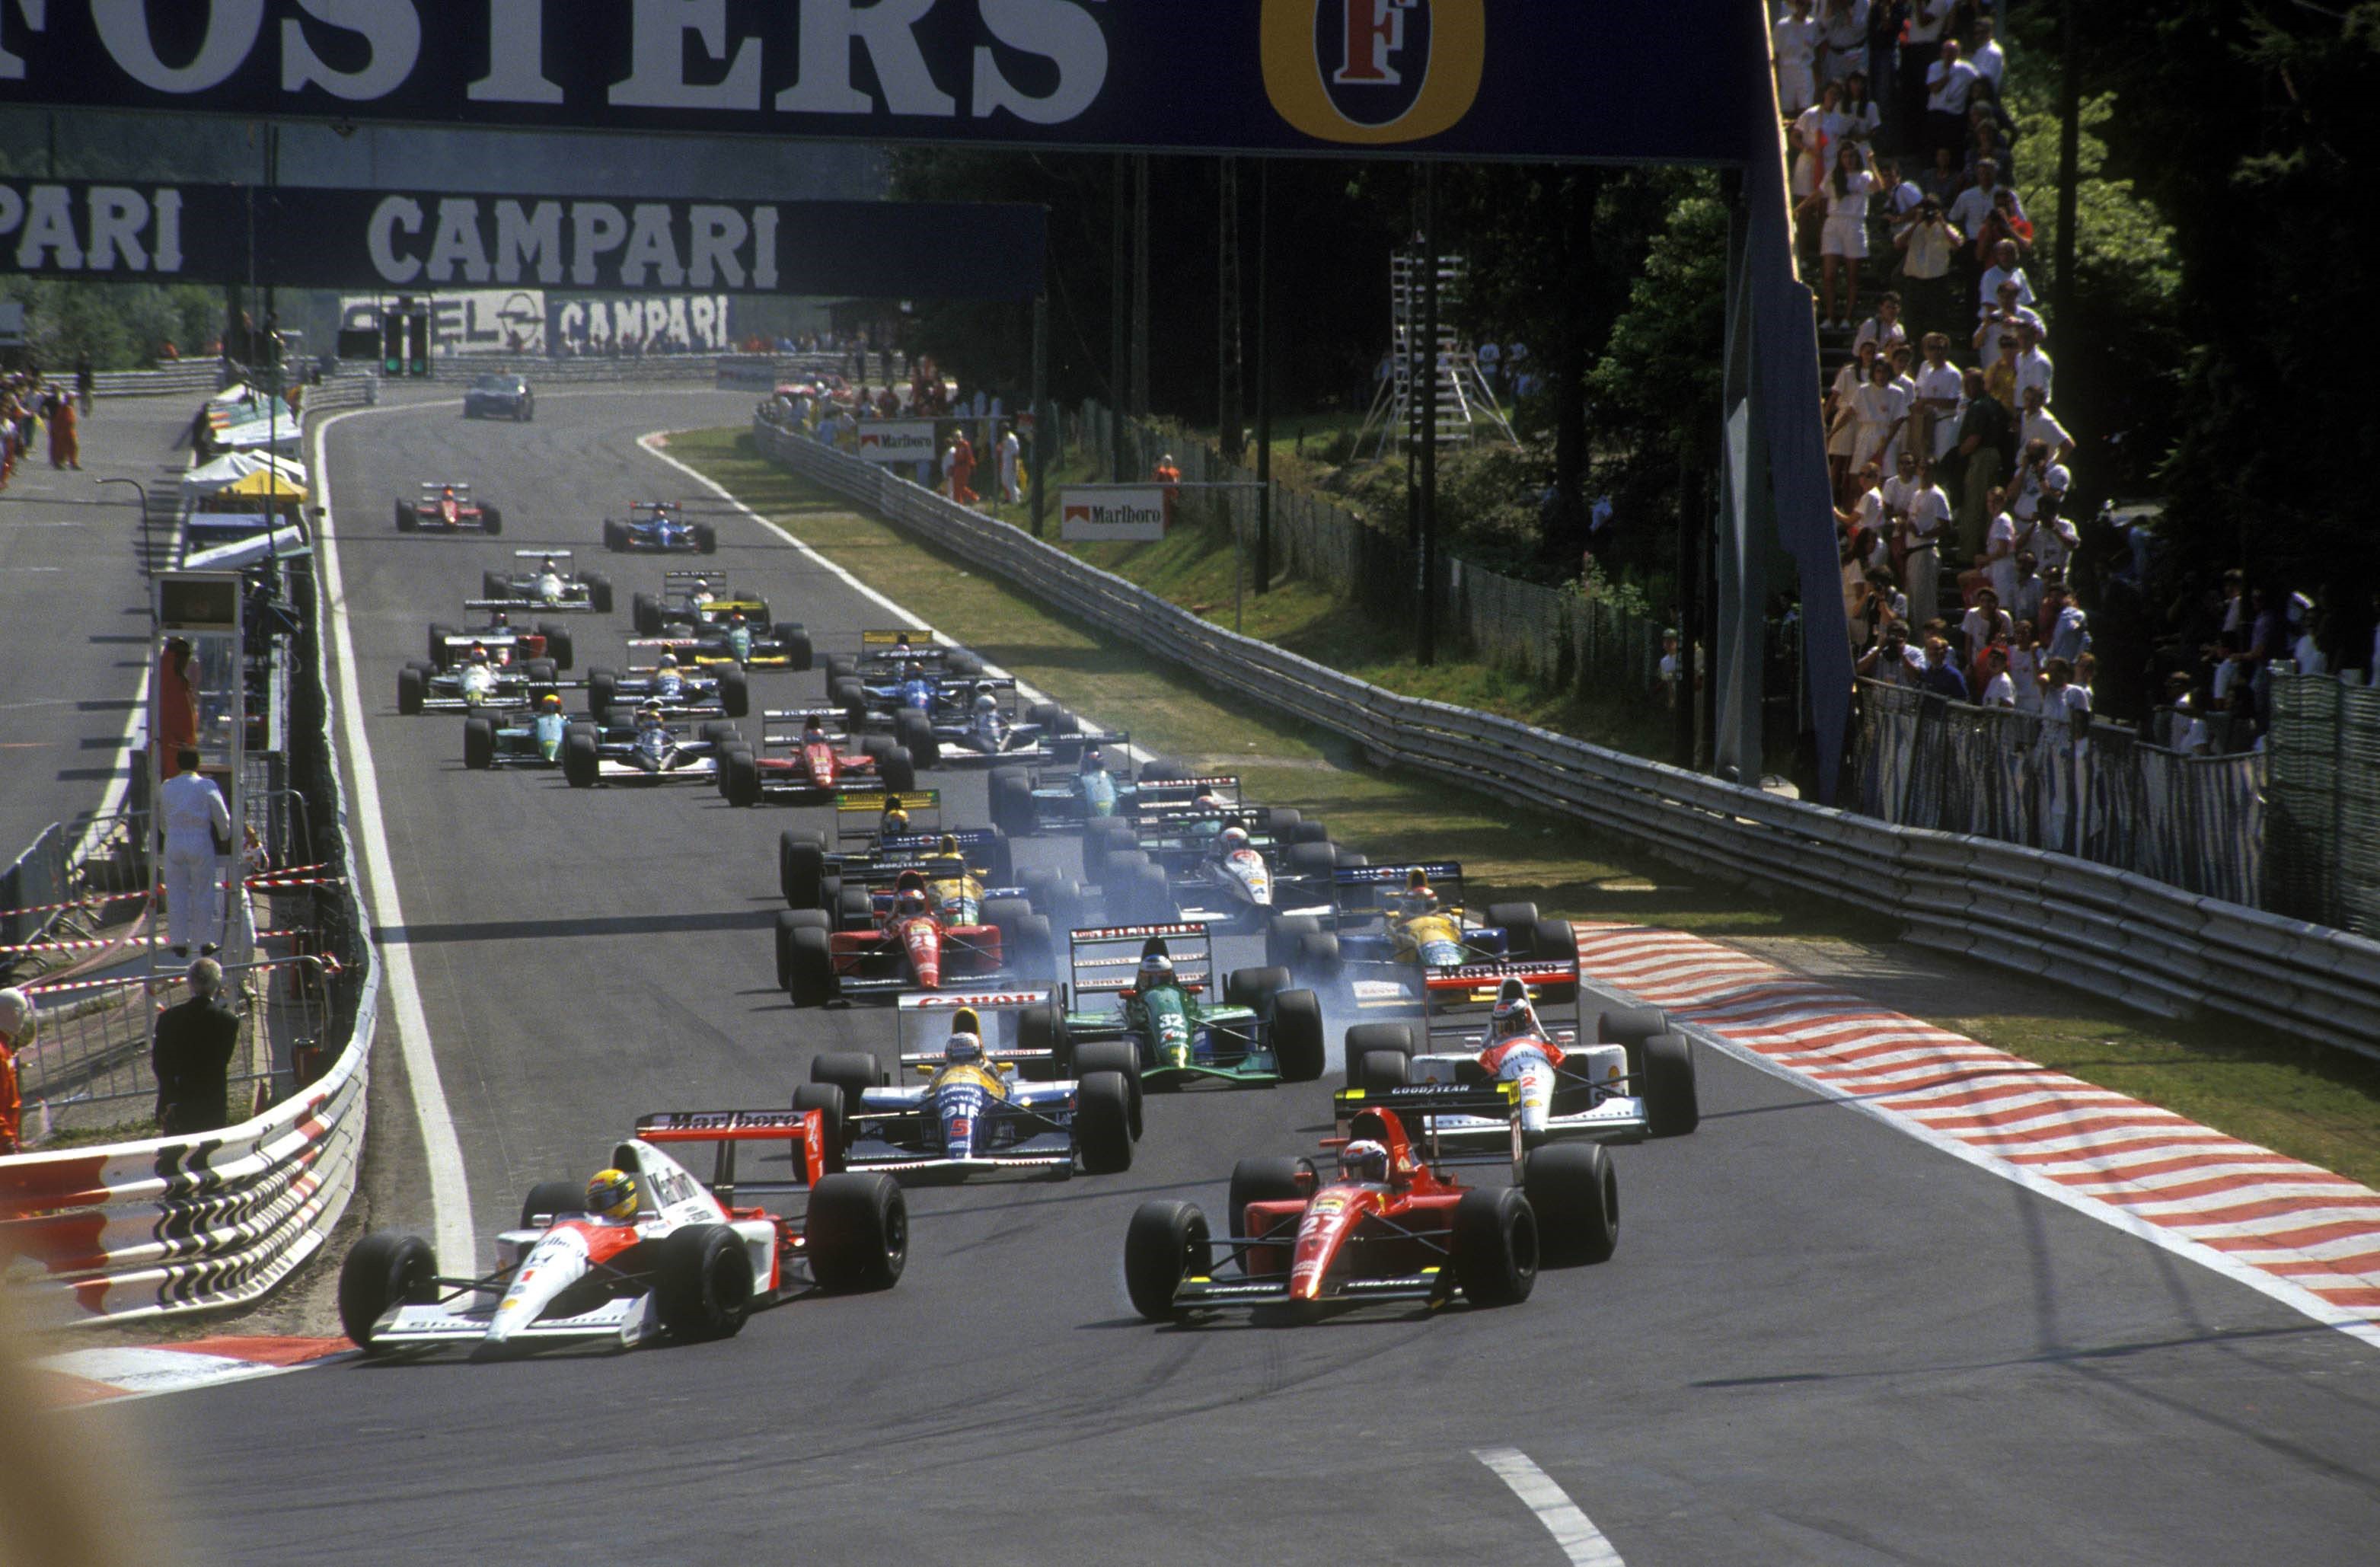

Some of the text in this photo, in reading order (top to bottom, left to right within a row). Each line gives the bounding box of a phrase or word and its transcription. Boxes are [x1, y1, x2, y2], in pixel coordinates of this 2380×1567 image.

[367, 196, 779, 289] CAMPARI
[560, 294, 729, 353] CAMPARI
[881, 433, 932, 448] Marlboro
[1092, 504, 1161, 524] Marlboro
[1439, 961, 1558, 980] Marlboro
[918, 993, 1036, 1008] Canon
[1159, 1013, 1185, 1029] 32
[1392, 1083, 1470, 1095] GOODYEAR
[1522, 1076, 1537, 1088] 2
[667, 1111, 802, 1131] Marlboro
[950, 1119, 971, 1136] 5
[1299, 1215, 1345, 1237] 27
